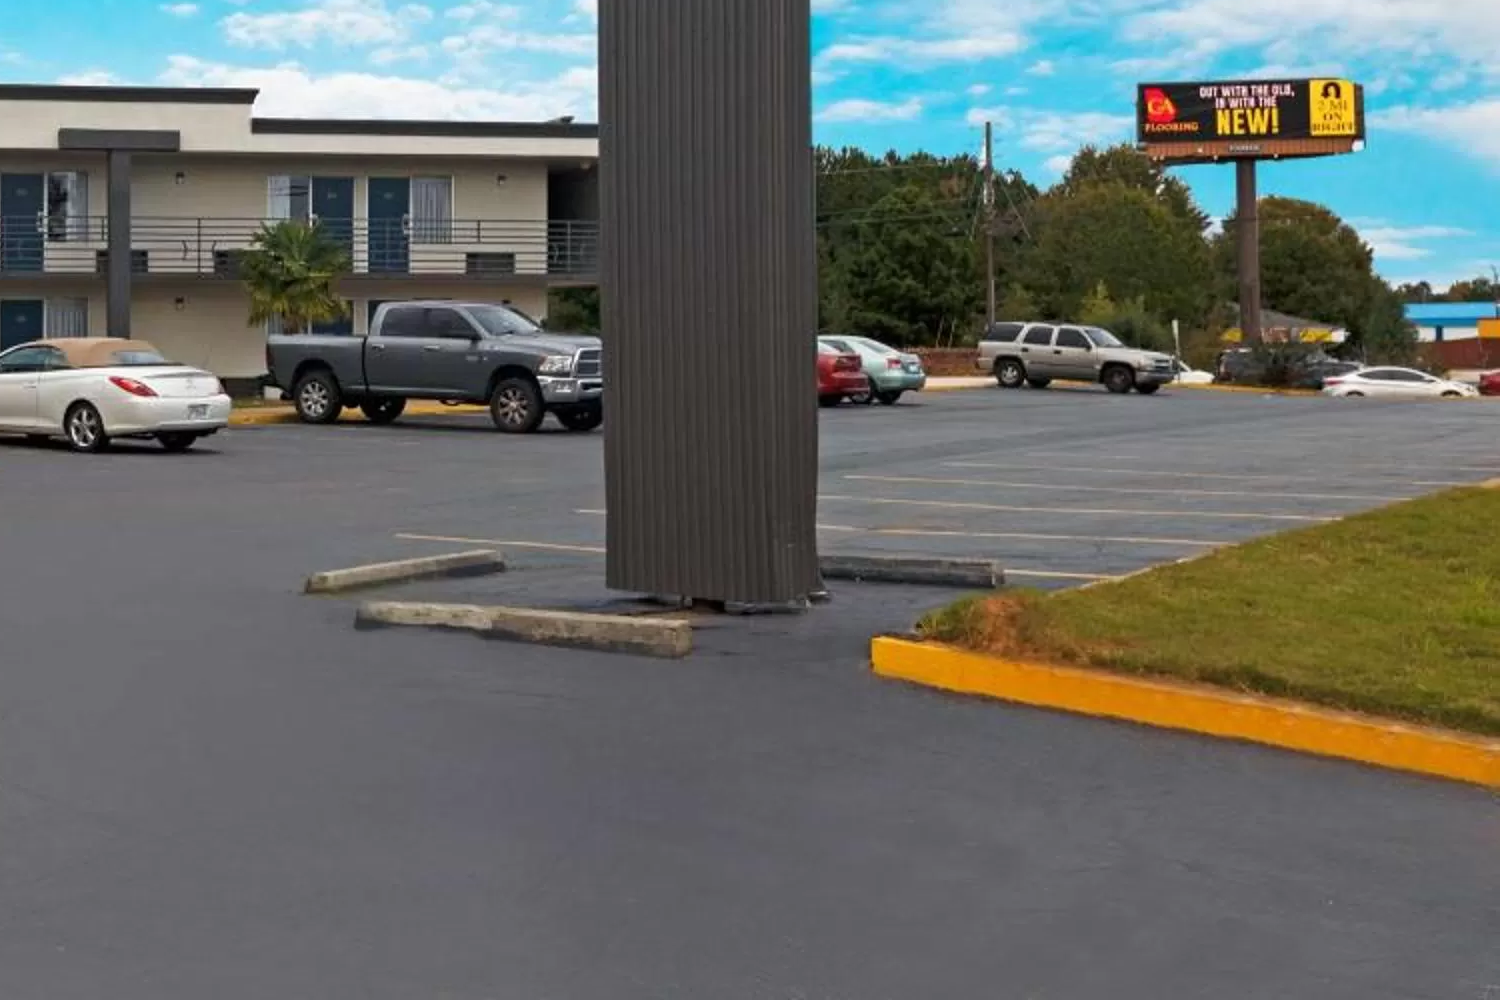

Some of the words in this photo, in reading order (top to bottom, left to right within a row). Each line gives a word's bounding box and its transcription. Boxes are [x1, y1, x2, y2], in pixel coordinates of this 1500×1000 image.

[1199, 86, 1218, 98] OUT
[1221, 85, 1249, 97] WITH
[1251, 85, 1269, 97] THE
[1215, 98, 1226, 109] IN
[1228, 97, 1256, 108] WITH
[1258, 96, 1277, 107] THE
[1216, 108, 1279, 135] NEW!
